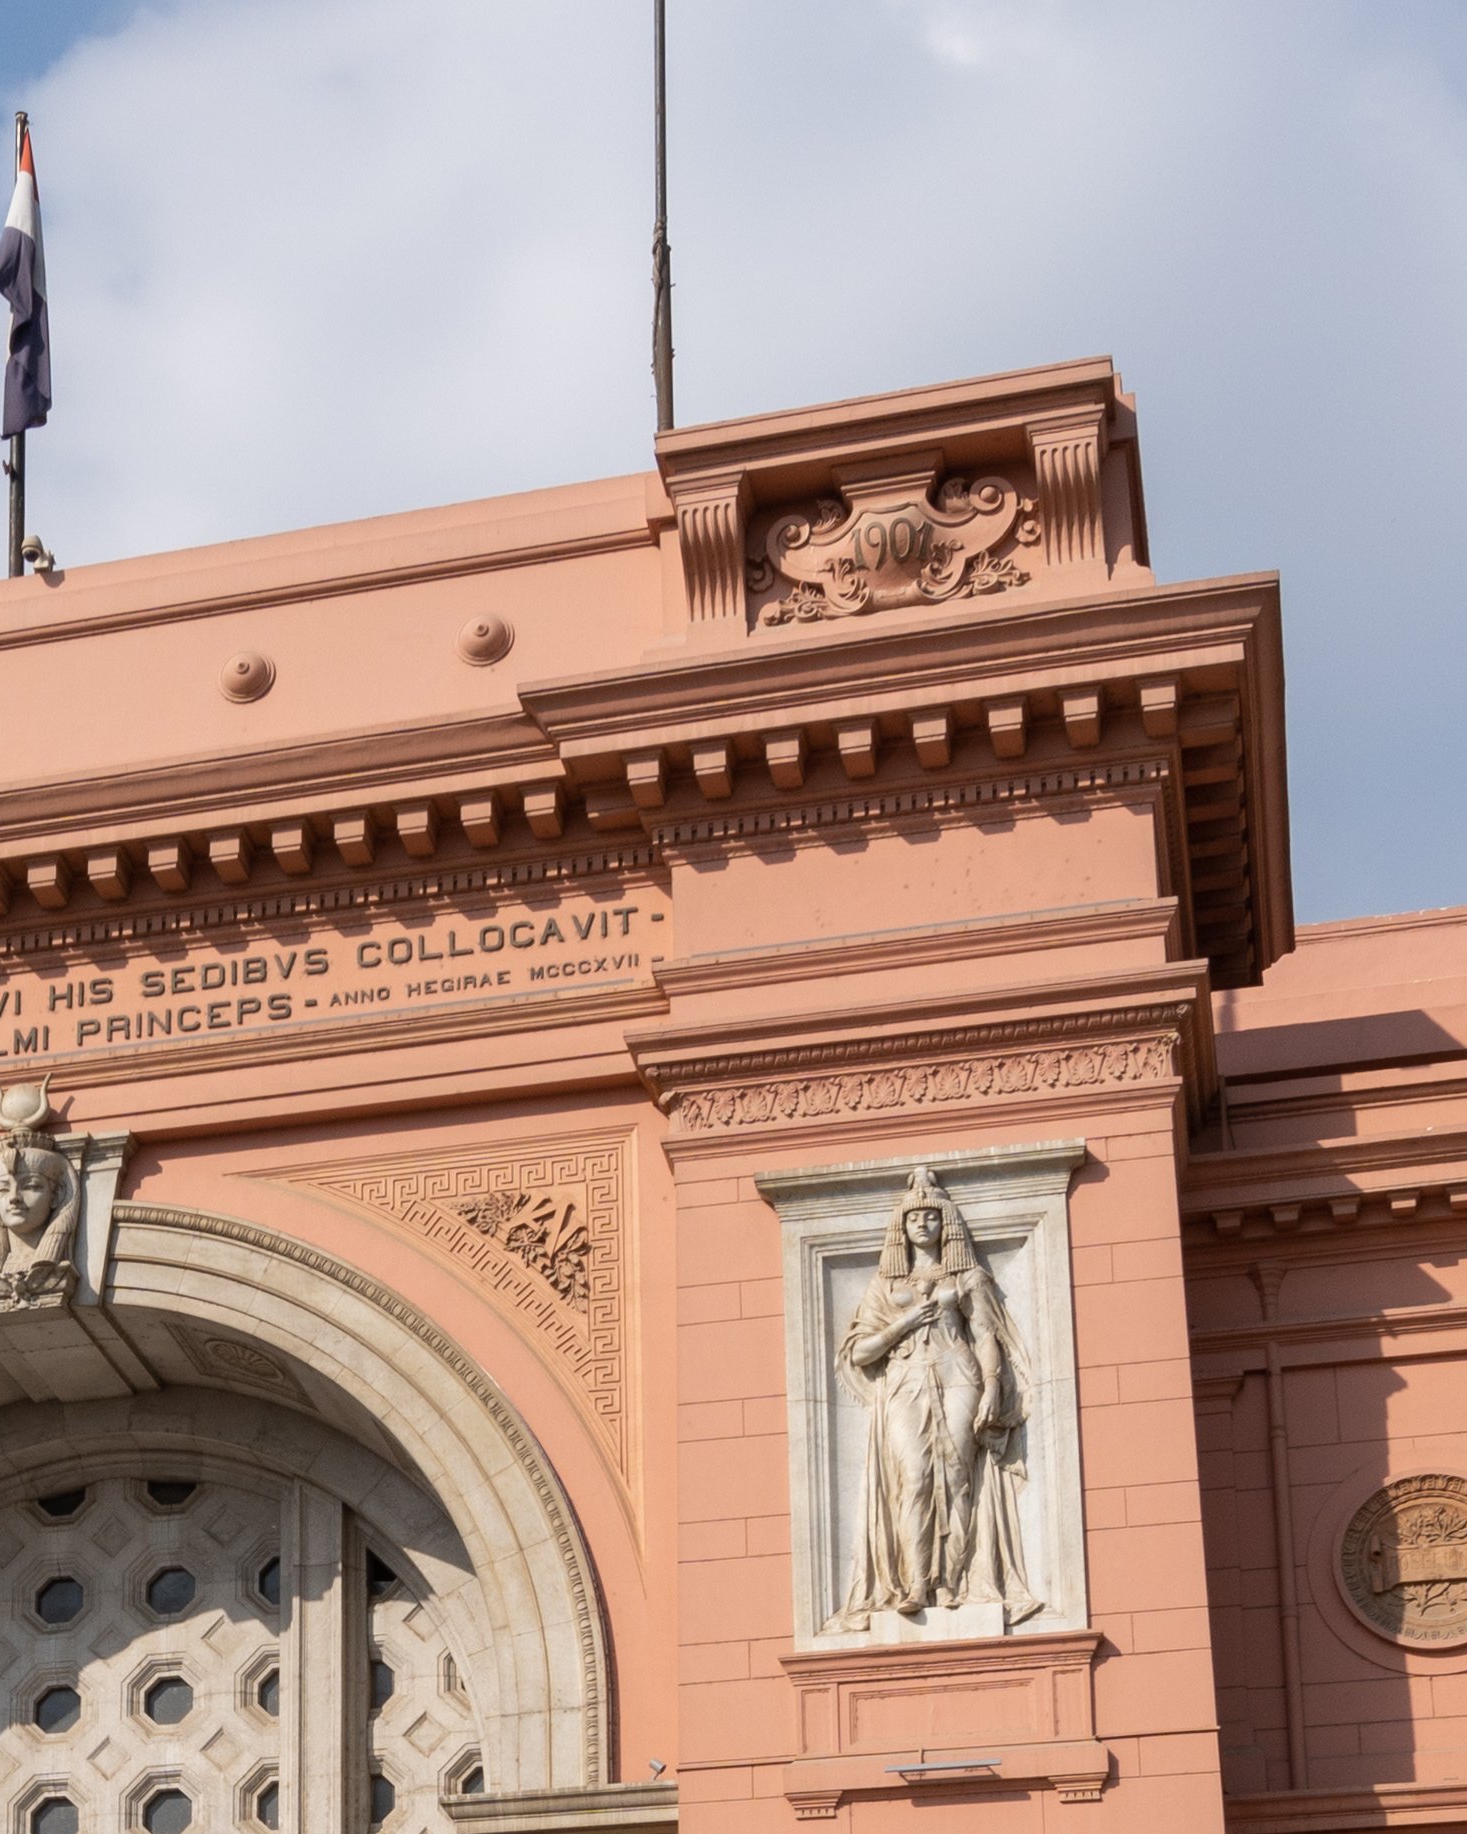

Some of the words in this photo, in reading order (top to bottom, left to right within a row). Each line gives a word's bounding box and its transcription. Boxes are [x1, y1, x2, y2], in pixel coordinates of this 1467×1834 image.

[49, 977, 114, 1012] HIS
[141, 948, 330, 997] SEDIBVS
[357, 906, 640, 968] COLLOCAVIT
[76, 993, 293, 1046] PRINCEPS
[329, 986, 391, 1008] ANNO
[407, 970, 512, 998] HEGIRAE
[530, 953, 640, 982] MCCCXVII
